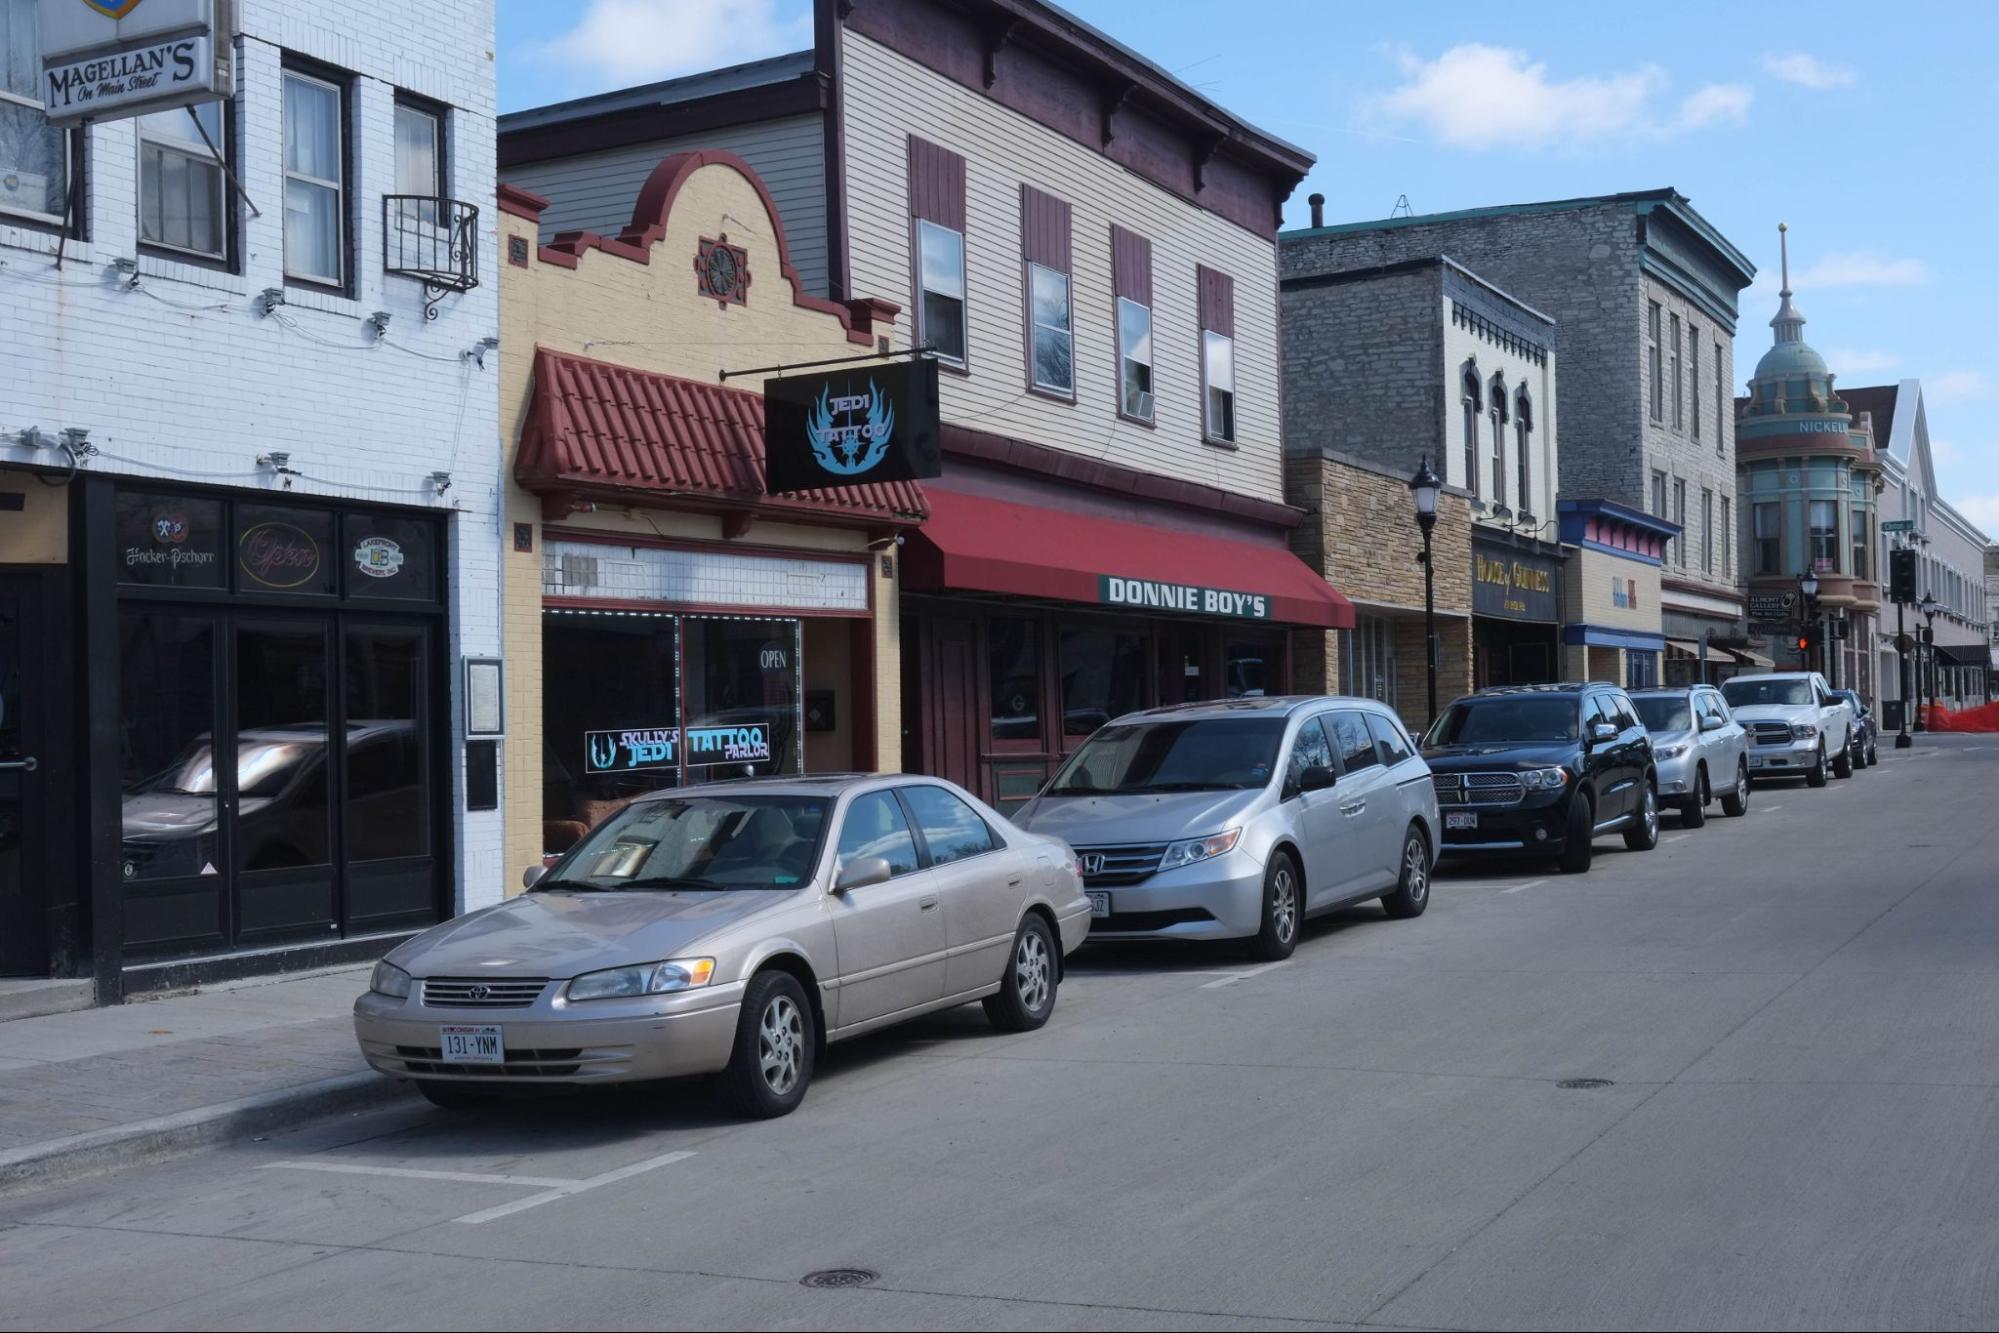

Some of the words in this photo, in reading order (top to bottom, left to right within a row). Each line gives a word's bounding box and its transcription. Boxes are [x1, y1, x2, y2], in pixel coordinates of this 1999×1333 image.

[48, 43, 195, 108] MAGELLAN'S
[77, 86, 93, 102] On
[97, 79, 125, 98] Main
[127, 72, 163, 92] Street
[829, 394, 869, 416] JEDI
[816, 423, 886, 443] TATTOO
[1109, 577, 1198, 610] DONNIE
[1205, 590, 1265, 617] BOY'S
[760, 649, 787, 669] OPEN
[619, 730, 679, 747] SKULLY'S
[687, 728, 762, 752] TATTOO
[626, 743, 673, 768] JEDI
[724, 742, 768, 760] PARLOR
